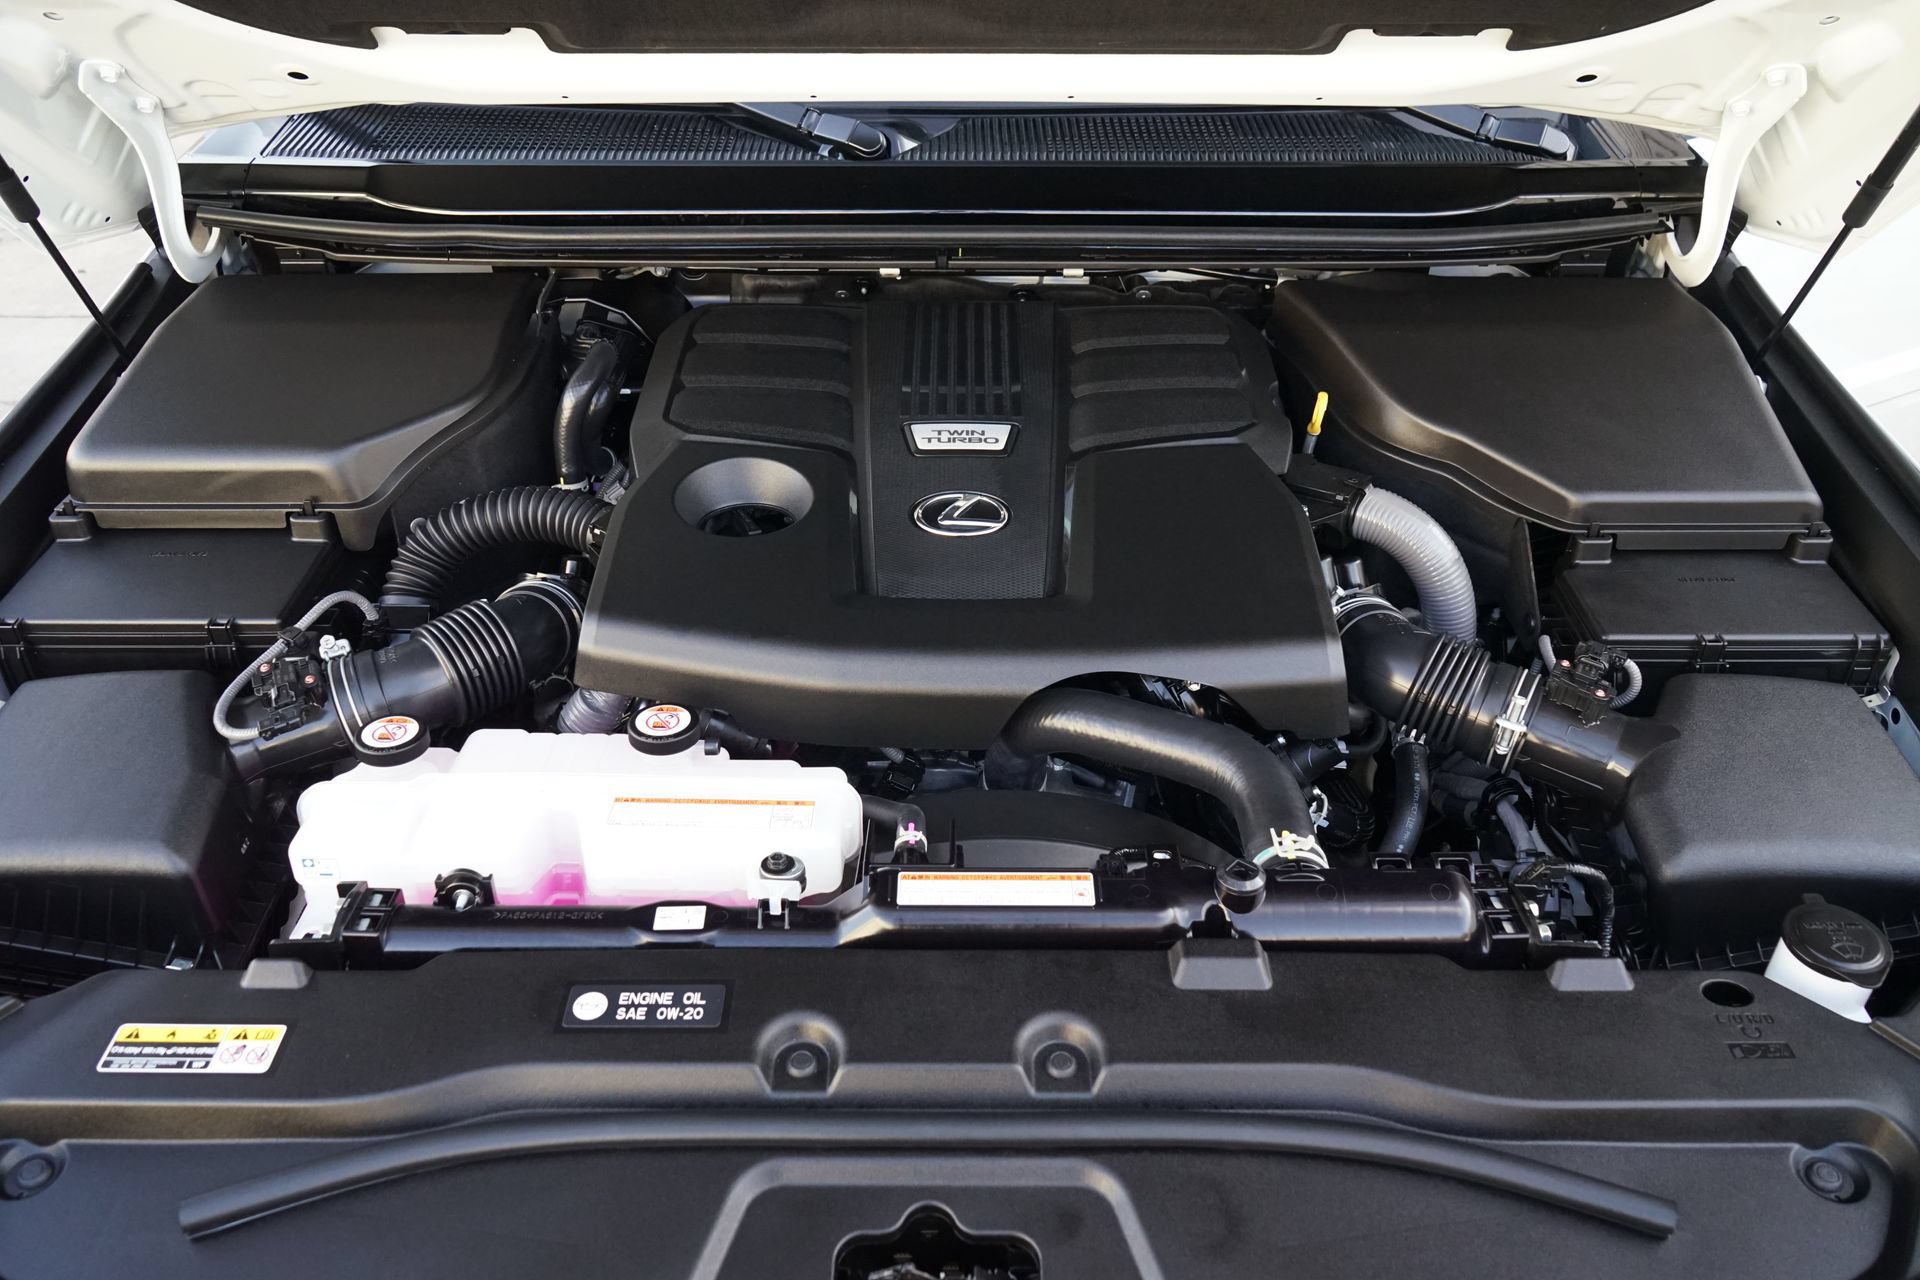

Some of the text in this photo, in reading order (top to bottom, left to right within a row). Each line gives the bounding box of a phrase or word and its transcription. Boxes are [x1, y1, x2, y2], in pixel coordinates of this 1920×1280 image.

[922, 436, 999, 444] TURBO
[618, 991, 706, 1005] ENGINE OIL
[615, 1007, 704, 1020] SAE 0W-20
